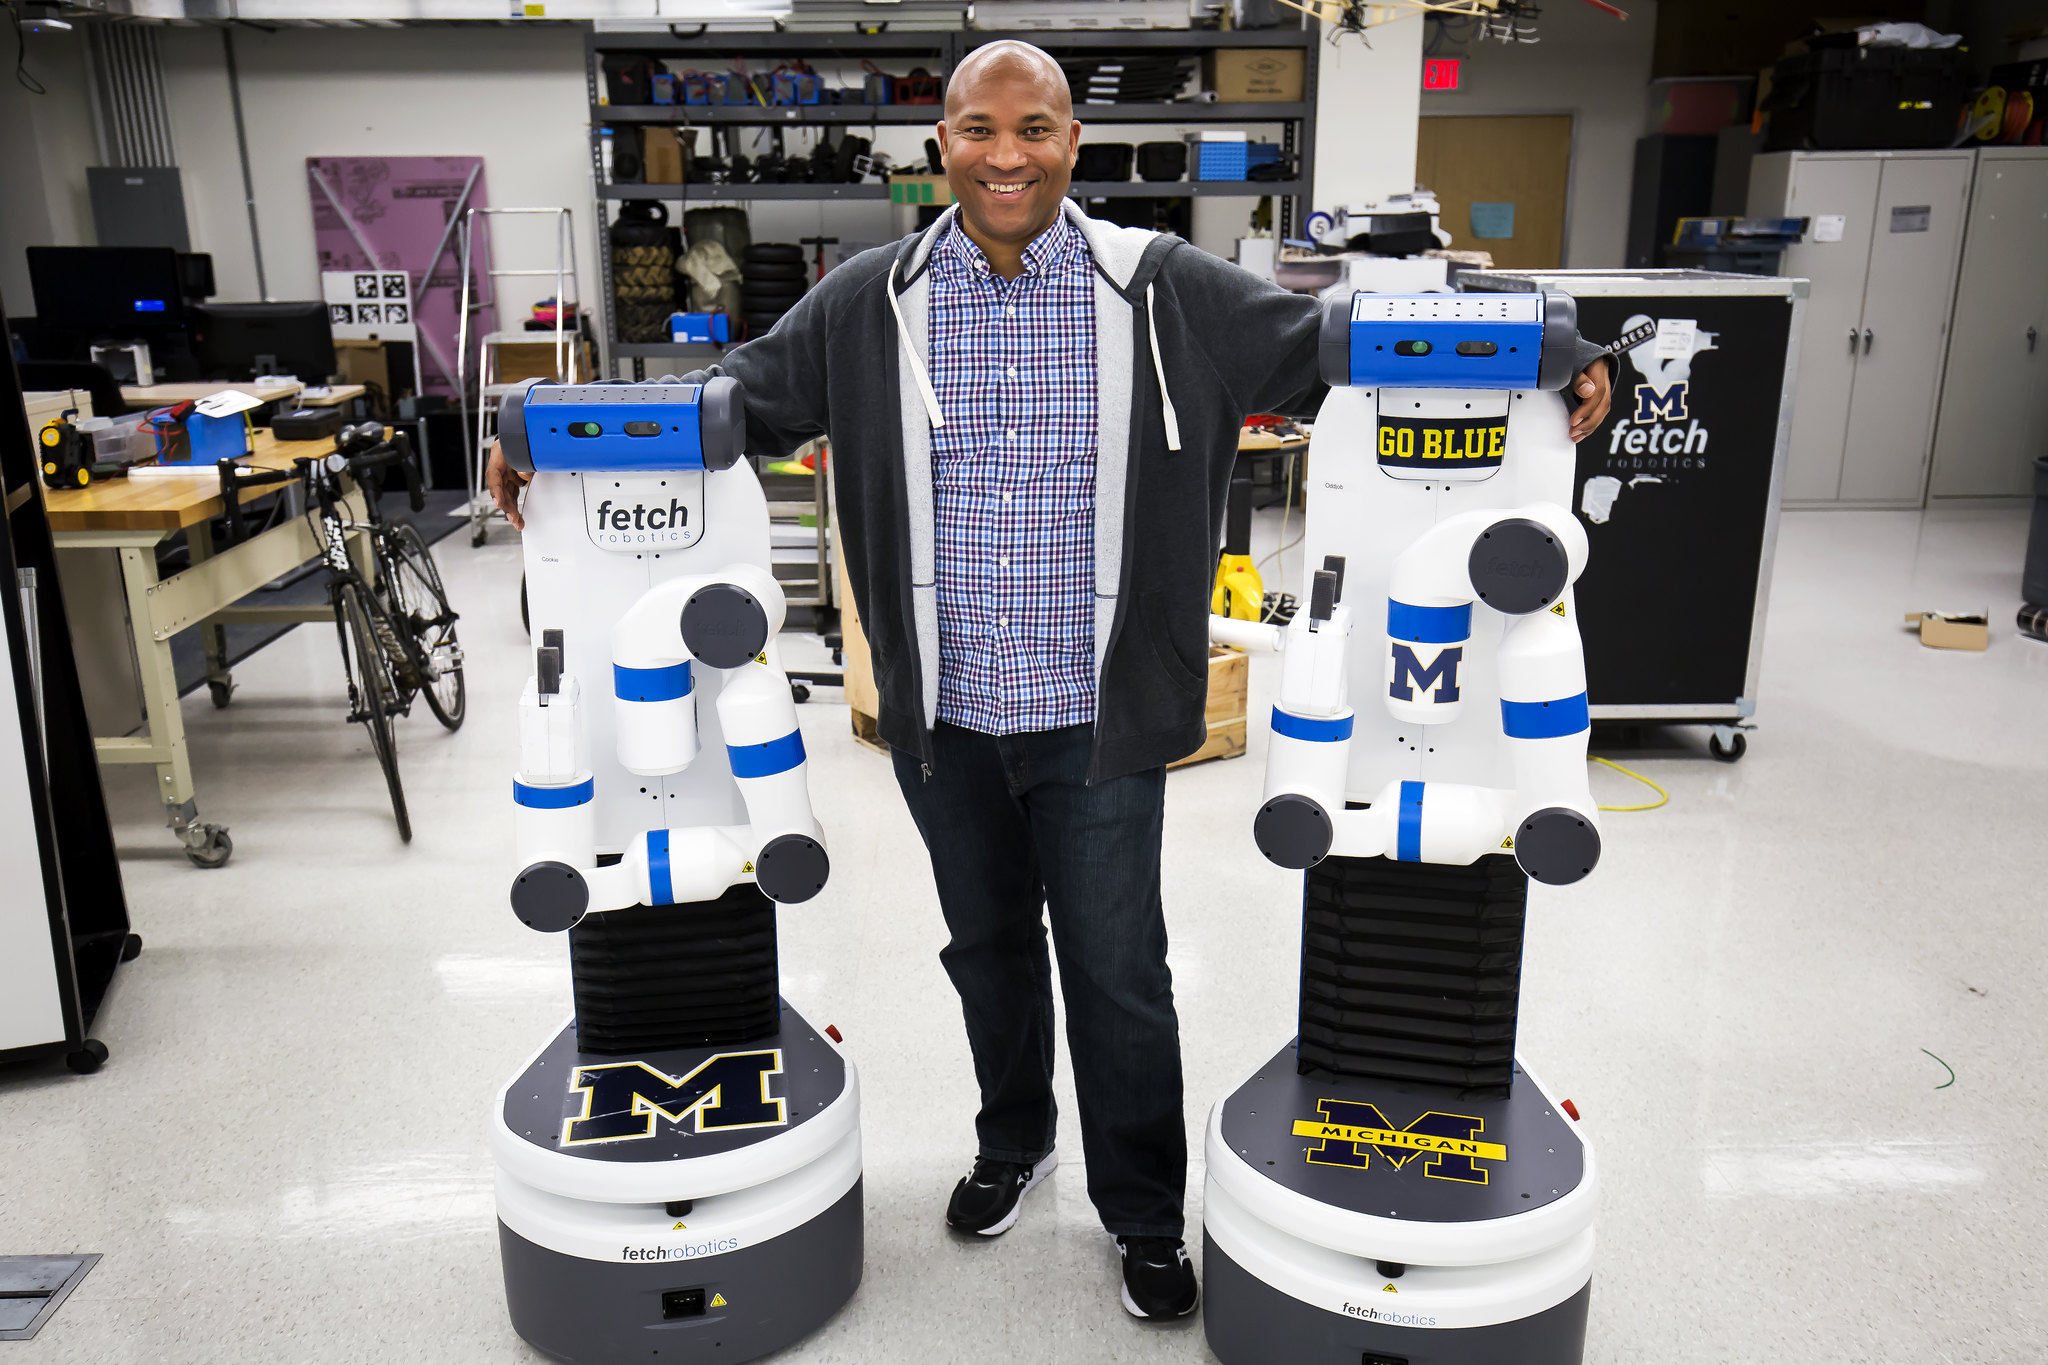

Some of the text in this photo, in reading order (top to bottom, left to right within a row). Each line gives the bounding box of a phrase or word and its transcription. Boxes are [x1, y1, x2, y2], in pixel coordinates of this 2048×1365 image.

[1424, 59, 1461, 89] EXIT
[1634, 379, 1688, 424] M
[1379, 425, 1506, 459] GO BLUE
[1609, 418, 1708, 454] fetch
[1606, 457, 1705, 469] robotics
[597, 498, 688, 531] fetch
[599, 530, 691, 544] robotics
[1388, 641, 1464, 704] M
[560, 1048, 788, 1147] M
[1320, 1126, 1478, 1154] MICHIGAN
